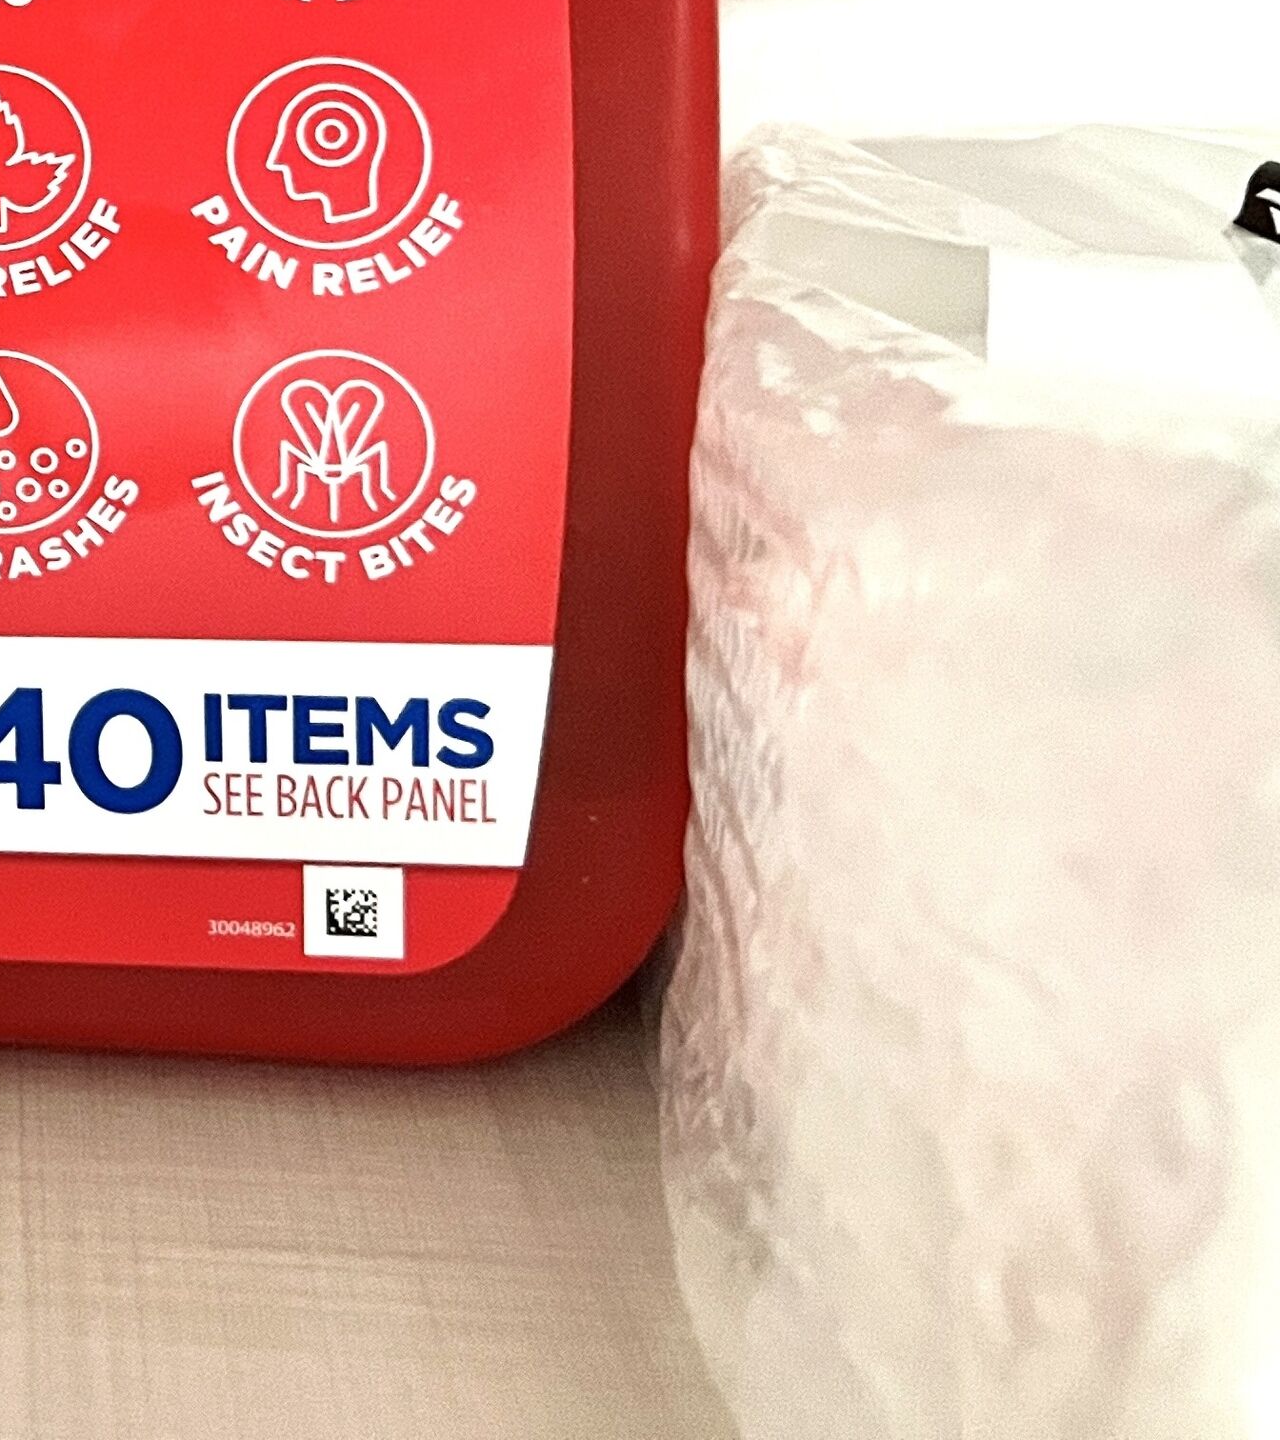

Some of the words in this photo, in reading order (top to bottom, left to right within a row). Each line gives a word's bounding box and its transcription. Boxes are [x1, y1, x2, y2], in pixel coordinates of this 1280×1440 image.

[190, 193, 296, 291] PAIN
[311, 192, 466, 297] RELIEF
[190, 470, 347, 584] INSECT
[357, 473, 479, 583] BITES
[202, 691, 496, 770] ITEMS
[202, 771, 265, 817] SEE
[276, 773, 368, 821] BACK
[382, 776, 498, 825] PANEL
[207, 919, 297, 939] 30048962
